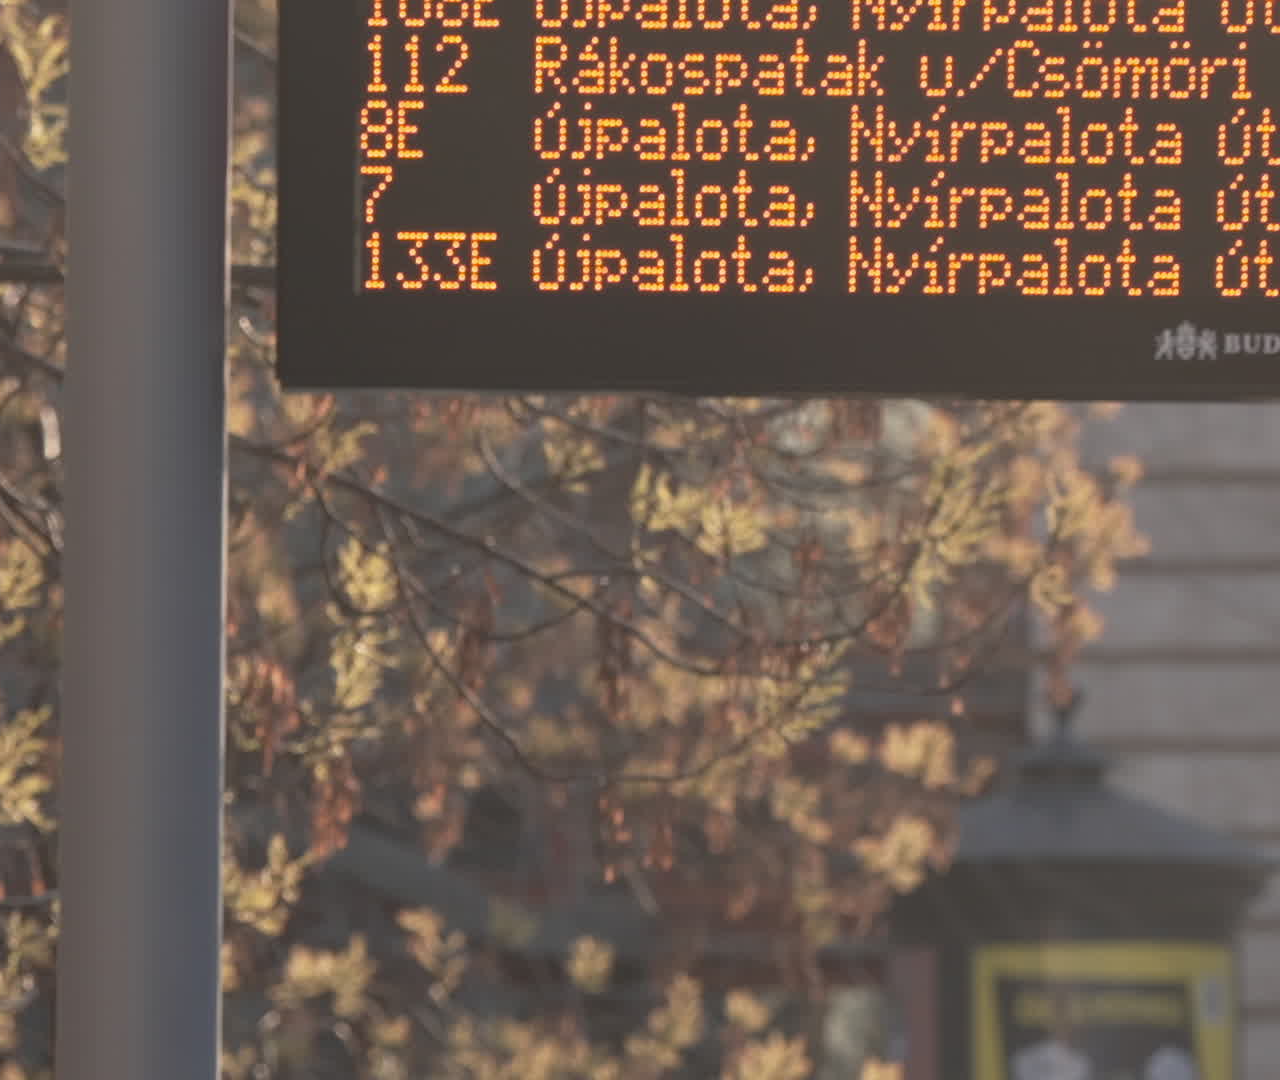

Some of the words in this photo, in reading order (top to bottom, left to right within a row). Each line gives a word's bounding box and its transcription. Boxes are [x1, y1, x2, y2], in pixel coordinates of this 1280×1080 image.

[368, 34, 468, 93] 112
[535, 36, 884, 96] Rákospatak
[920, 38, 1252, 99] u/Csömöri
[360, 100, 424, 159] 8E
[534, 102, 816, 161] Újpalota,
[850, 104, 1182, 164] Nyírpalota
[1218, 107, 1280, 165] út
[360, 166, 393, 223] 7
[533, 168, 814, 227] Újpalota,
[848, 170, 1181, 230] Nyírpalota
[1217, 173, 1280, 231] út
[365, 232, 497, 290] 133E
[532, 233, 813, 293] Újpalota,
[848, 236, 1180, 296] Nyírpalota
[1216, 239, 1280, 297] út
